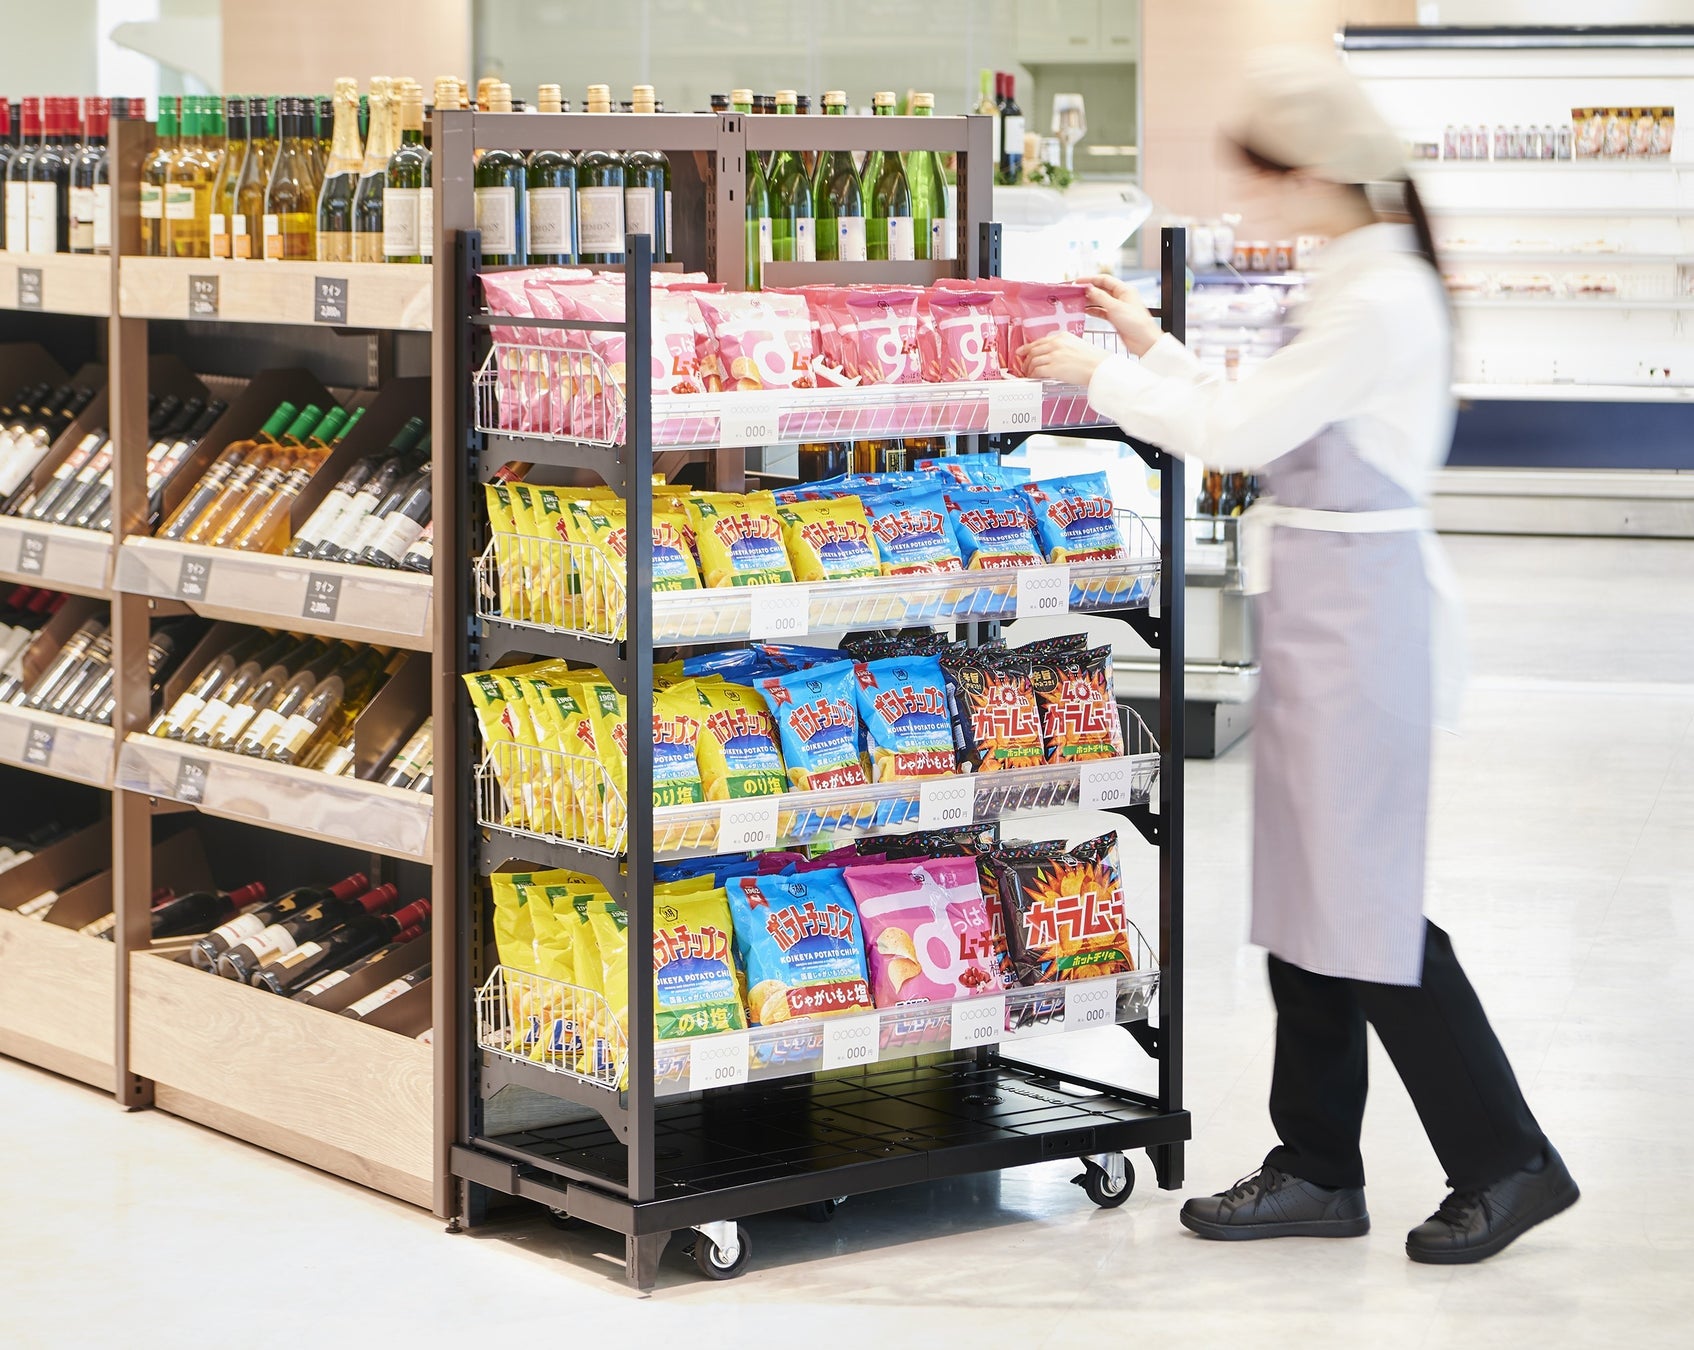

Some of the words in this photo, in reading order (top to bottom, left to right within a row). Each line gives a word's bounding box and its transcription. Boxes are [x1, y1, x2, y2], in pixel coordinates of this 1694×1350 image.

[858, 306, 918, 384] す
[939, 304, 994, 381] す
[713, 513, 782, 548] ポテトチップス
[801, 519, 869, 551] ポテトチップス
[871, 509, 944, 543] ポテトチップス
[987, 682, 1030, 707] 40th
[1061, 678, 1102, 703] 40th
[874, 685, 948, 724] ポテトチップス
[913, 723, 935, 732] POTATO
[654, 754, 682, 764] POTATO
[744, 746, 769, 754] POTATO
[743, 777, 781, 795] のり塩
[765, 900, 854, 952] ポテトチップス
[859, 865, 982, 997] す
[780, 953, 814, 964] KOIKEYA
[813, 949, 840, 959] POTATO
[840, 947, 860, 956] CHIPS
[1072, 951, 1117, 967] ホットチリ味
[655, 975, 684, 986] OIKEYA
[684, 972, 715, 982] POTATO
[791, 984, 869, 1010] じゃがいもと塩
[678, 1006, 730, 1033] のり塩
